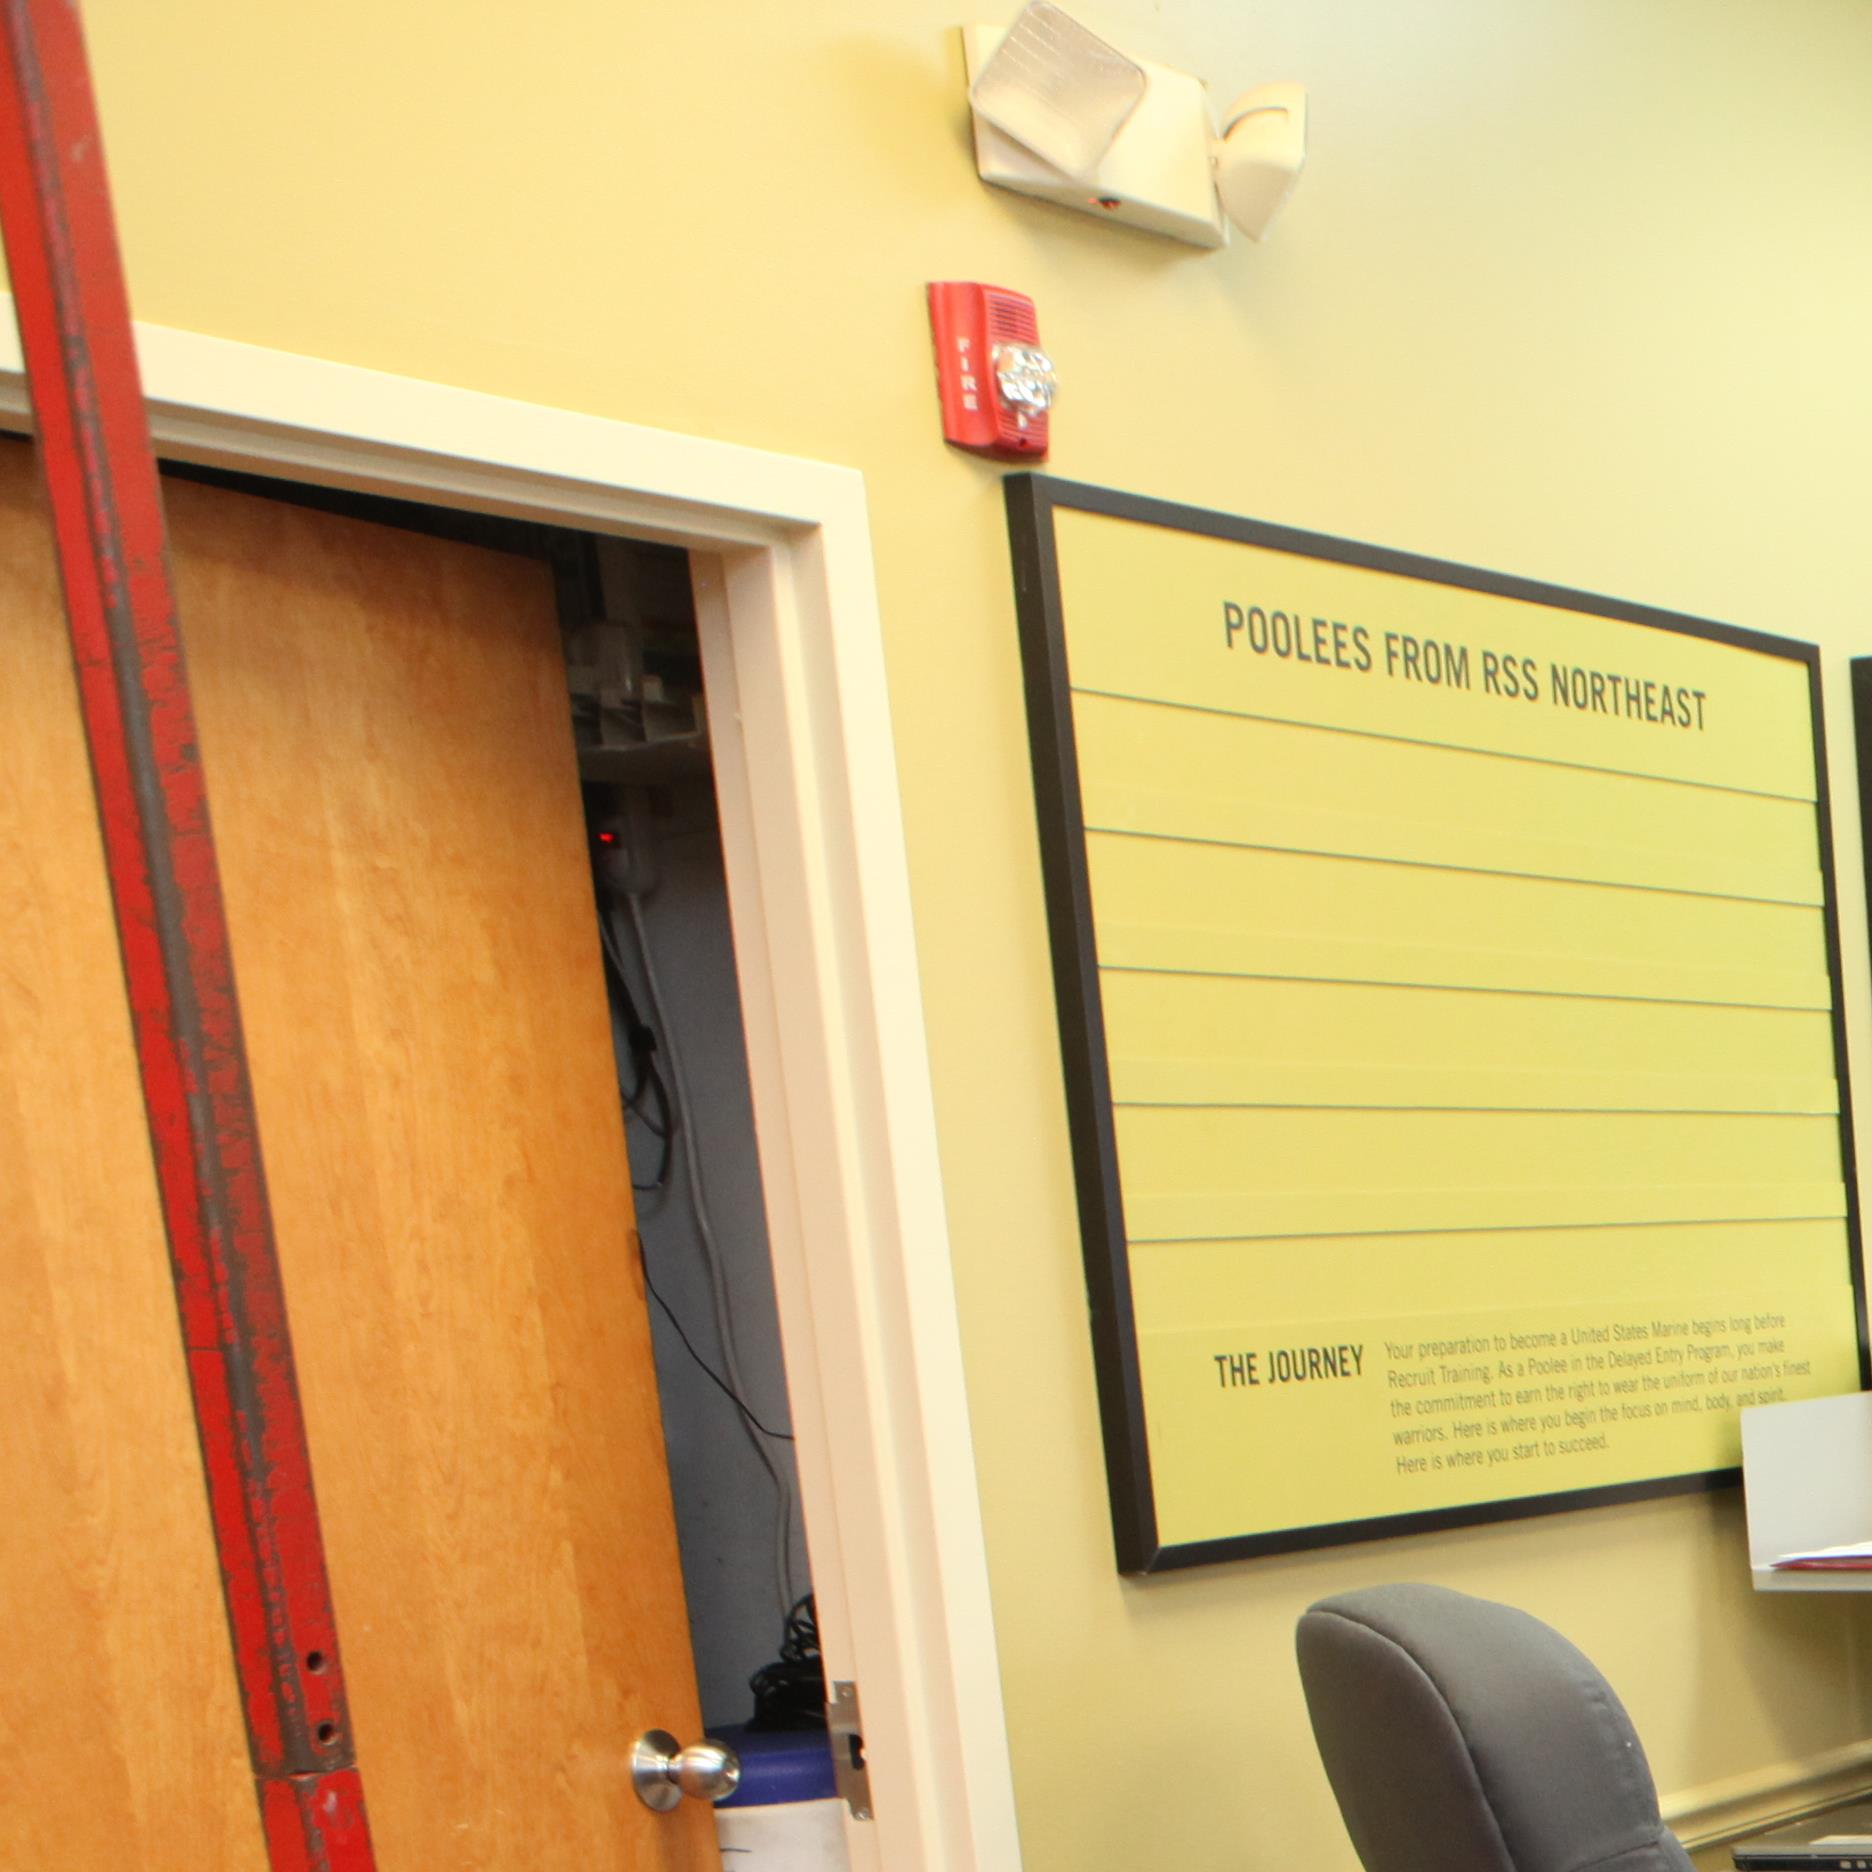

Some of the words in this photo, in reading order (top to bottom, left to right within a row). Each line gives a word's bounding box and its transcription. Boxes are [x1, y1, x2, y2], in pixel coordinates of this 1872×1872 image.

[957, 336, 978, 411] FIRE
[1222, 600, 1372, 673] POOLEES
[1384, 631, 1471, 691] FROM
[1481, 651, 1540, 702] RSS
[1550, 659, 1707, 732] NORTHEAST
[1384, 1341, 1413, 1360] Your
[1418, 1337, 1490, 1361] preparation
[1494, 1335, 1506, 1352] to
[1510, 1331, 1556, 1350] become
[1571, 1326, 1610, 1345] United
[1613, 1322, 1649, 1342] States
[1651, 1319, 1689, 1338] Marine
[1692, 1316, 1727, 1337] begins
[1729, 1314, 1751, 1335] long
[1753, 1312, 1786, 1330] before
[1214, 1353, 1261, 1390] THE
[1267, 1344, 1365, 1385] JOURNEY
[1387, 1368, 1436, 1389] Recruit
[1498, 1361, 1513, 1379] As
[1528, 1357, 1567, 1377] Poolee
[1571, 1356, 1582, 1371] in
[1586, 1353, 1604, 1370] the
[1608, 1347, 1652, 1369] Delayed
[1656, 1346, 1683, 1366] Entry
[1757, 1338, 1785, 1354] make
[1390, 1397, 1412, 1418] the
[1415, 1391, 1497, 1416] commitment
[1500, 1390, 1512, 1407] to
[1515, 1388, 1542, 1405] earn
[1545, 1383, 1565, 1401] the
[1568, 1381, 1595, 1402] right
[1598, 1379, 1610, 1397] to
[1613, 1378, 1639, 1394] wear
[1642, 1374, 1660, 1391] the
[1663, 1369, 1706, 1389] uniform
[1453, 1421, 1482, 1440] Here
[1487, 1418, 1498, 1436] is
[1500, 1415, 1537, 1434] where
[1539, 1411, 1561, 1432] you
[1565, 1408, 1597, 1429] begin
[1599, 1405, 1618, 1422] the
[1621, 1401, 1651, 1420] focus
[1396, 1455, 1427, 1474] Here
[1431, 1453, 1442, 1470] is
[1446, 1448, 1484, 1468] where
[1487, 1446, 1510, 1467] you
[1512, 1441, 1540, 1460] start
[1543, 1439, 1555, 1456] to
